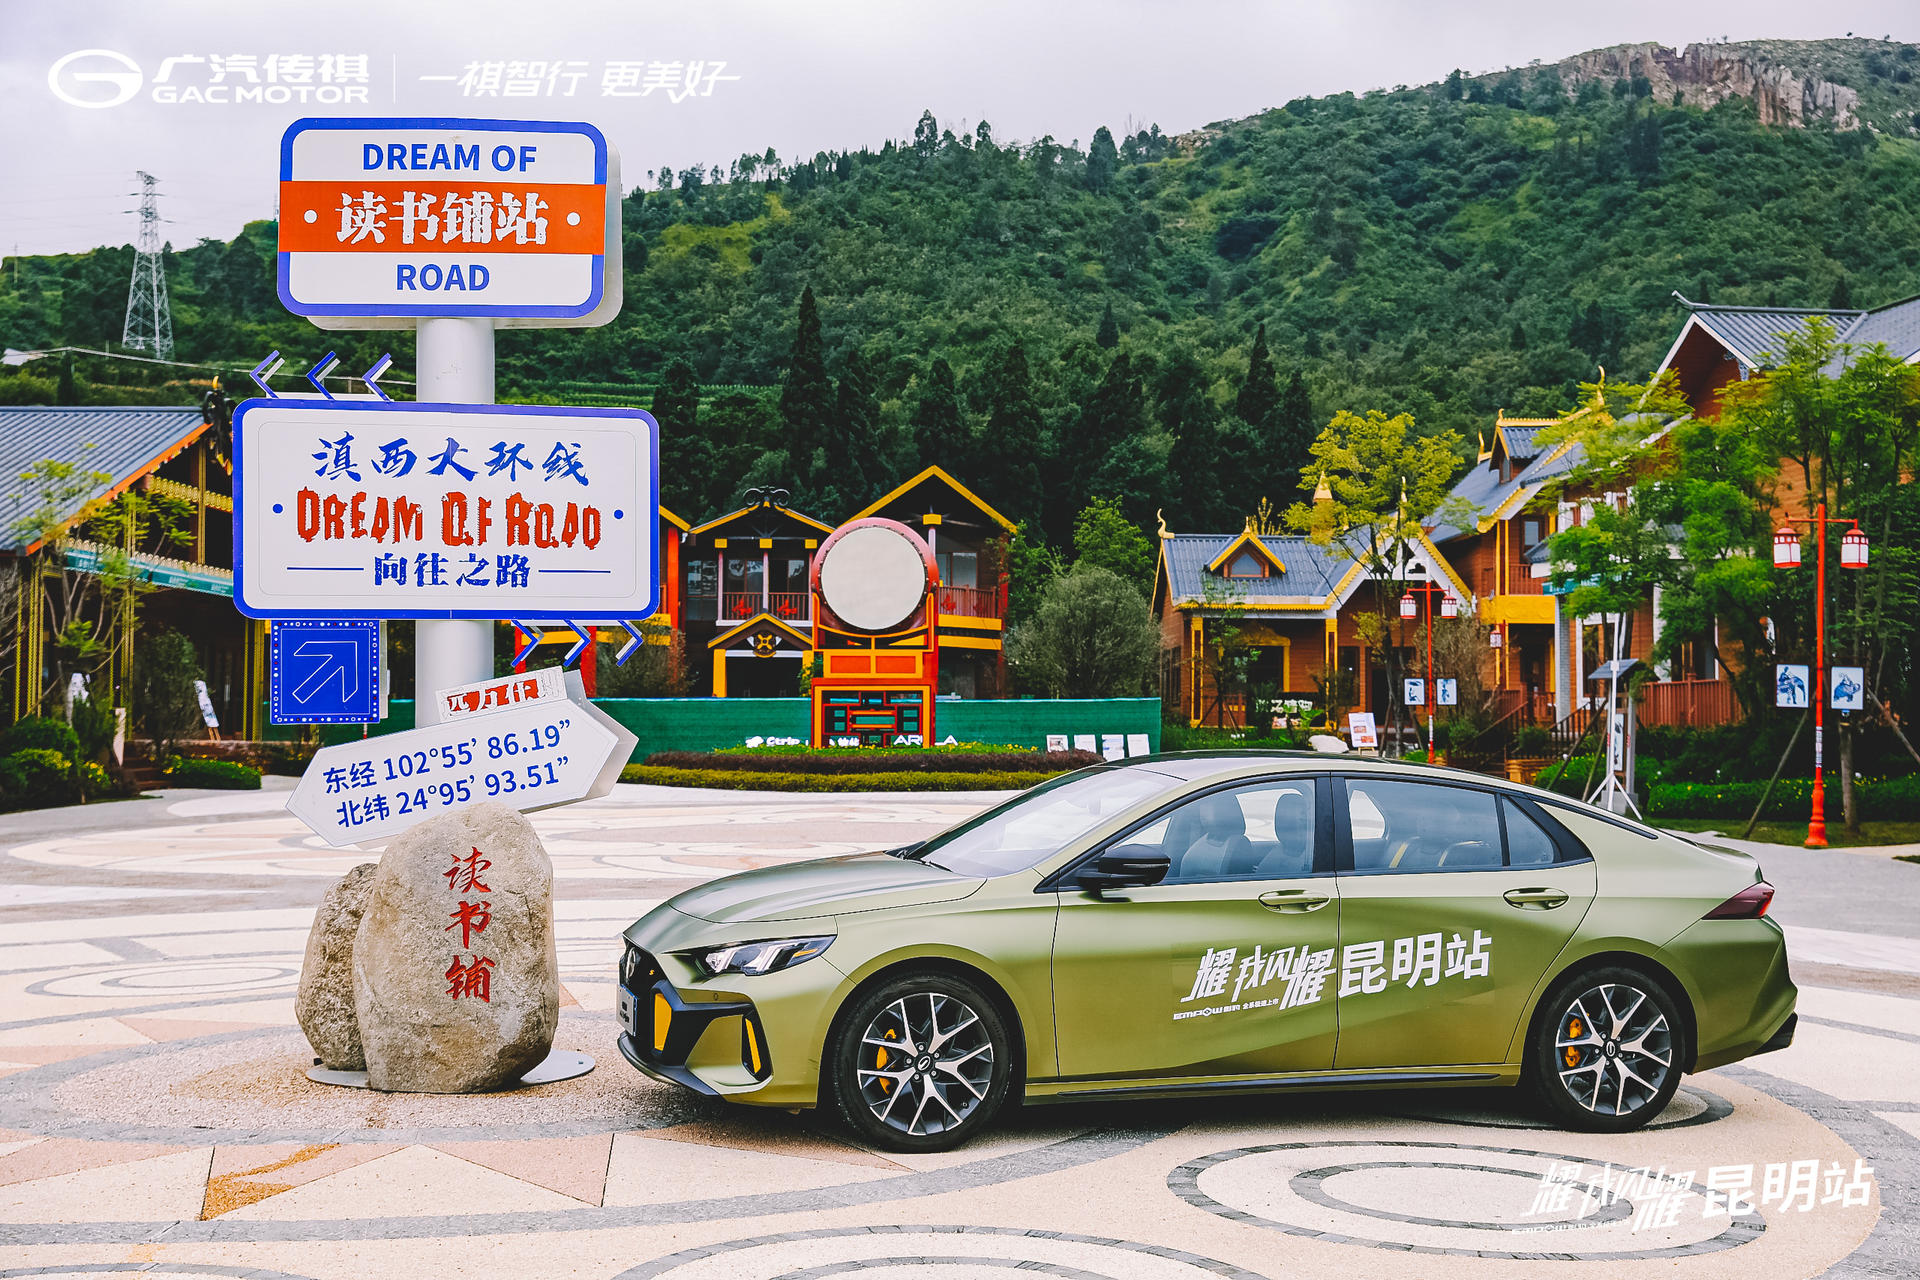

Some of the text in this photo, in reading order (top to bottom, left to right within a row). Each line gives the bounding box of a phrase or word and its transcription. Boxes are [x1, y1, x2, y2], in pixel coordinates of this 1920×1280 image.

[362, 143, 537, 173] DREAM OF
[335, 191, 549, 245] 读书铺站
[396, 263, 490, 292] ROAD
[311, 431, 590, 487] 滇西大环线
[297, 487, 602, 551] DREAM OF ROAD
[374, 552, 531, 589] 向往之路
[322, 760, 377, 795] 东经
[336, 793, 391, 828] 北纬
[443, 847, 496, 1004] 读书铺
[1337, 930, 1492, 999] 昆明站
